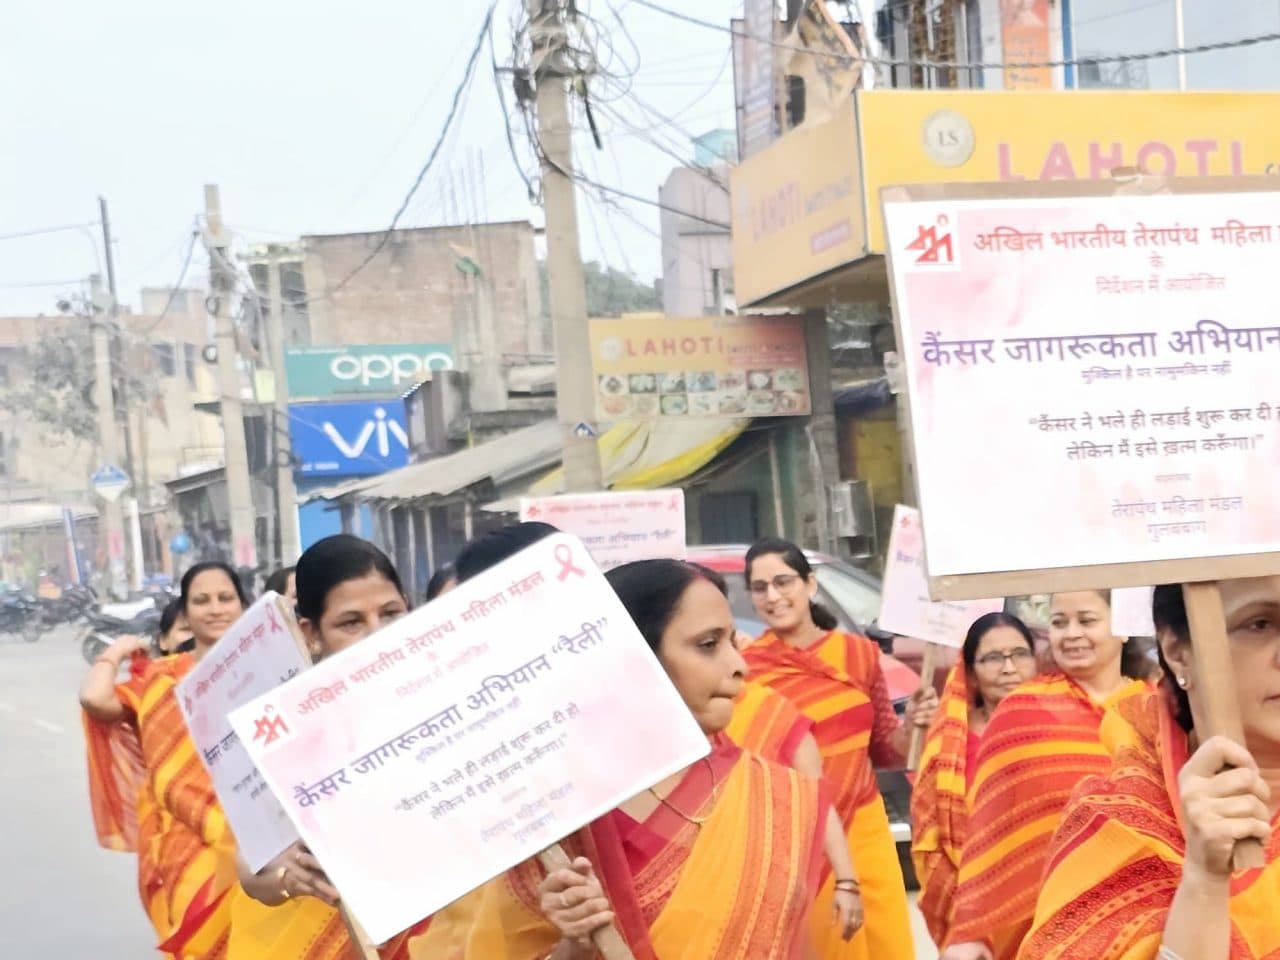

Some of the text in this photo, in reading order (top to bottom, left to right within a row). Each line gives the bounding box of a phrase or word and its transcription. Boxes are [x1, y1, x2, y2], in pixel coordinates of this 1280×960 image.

[997, 140, 1242, 182] LAHOTI
[974, 225, 1043, 252] अखिल
[1049, 223, 1127, 250] भारतीय
[1133, 221, 1199, 247] तेरापंथ
[1210, 218, 1272, 247] महिला
[624, 335, 725, 357] LAHOTI
[920, 330, 996, 367] कैंसर
[1002, 331, 1158, 363] जागरूकता
[330, 351, 454, 387] oppo
[293, 767, 352, 808] कैंसर
[466, 653, 552, 711] अभियान
